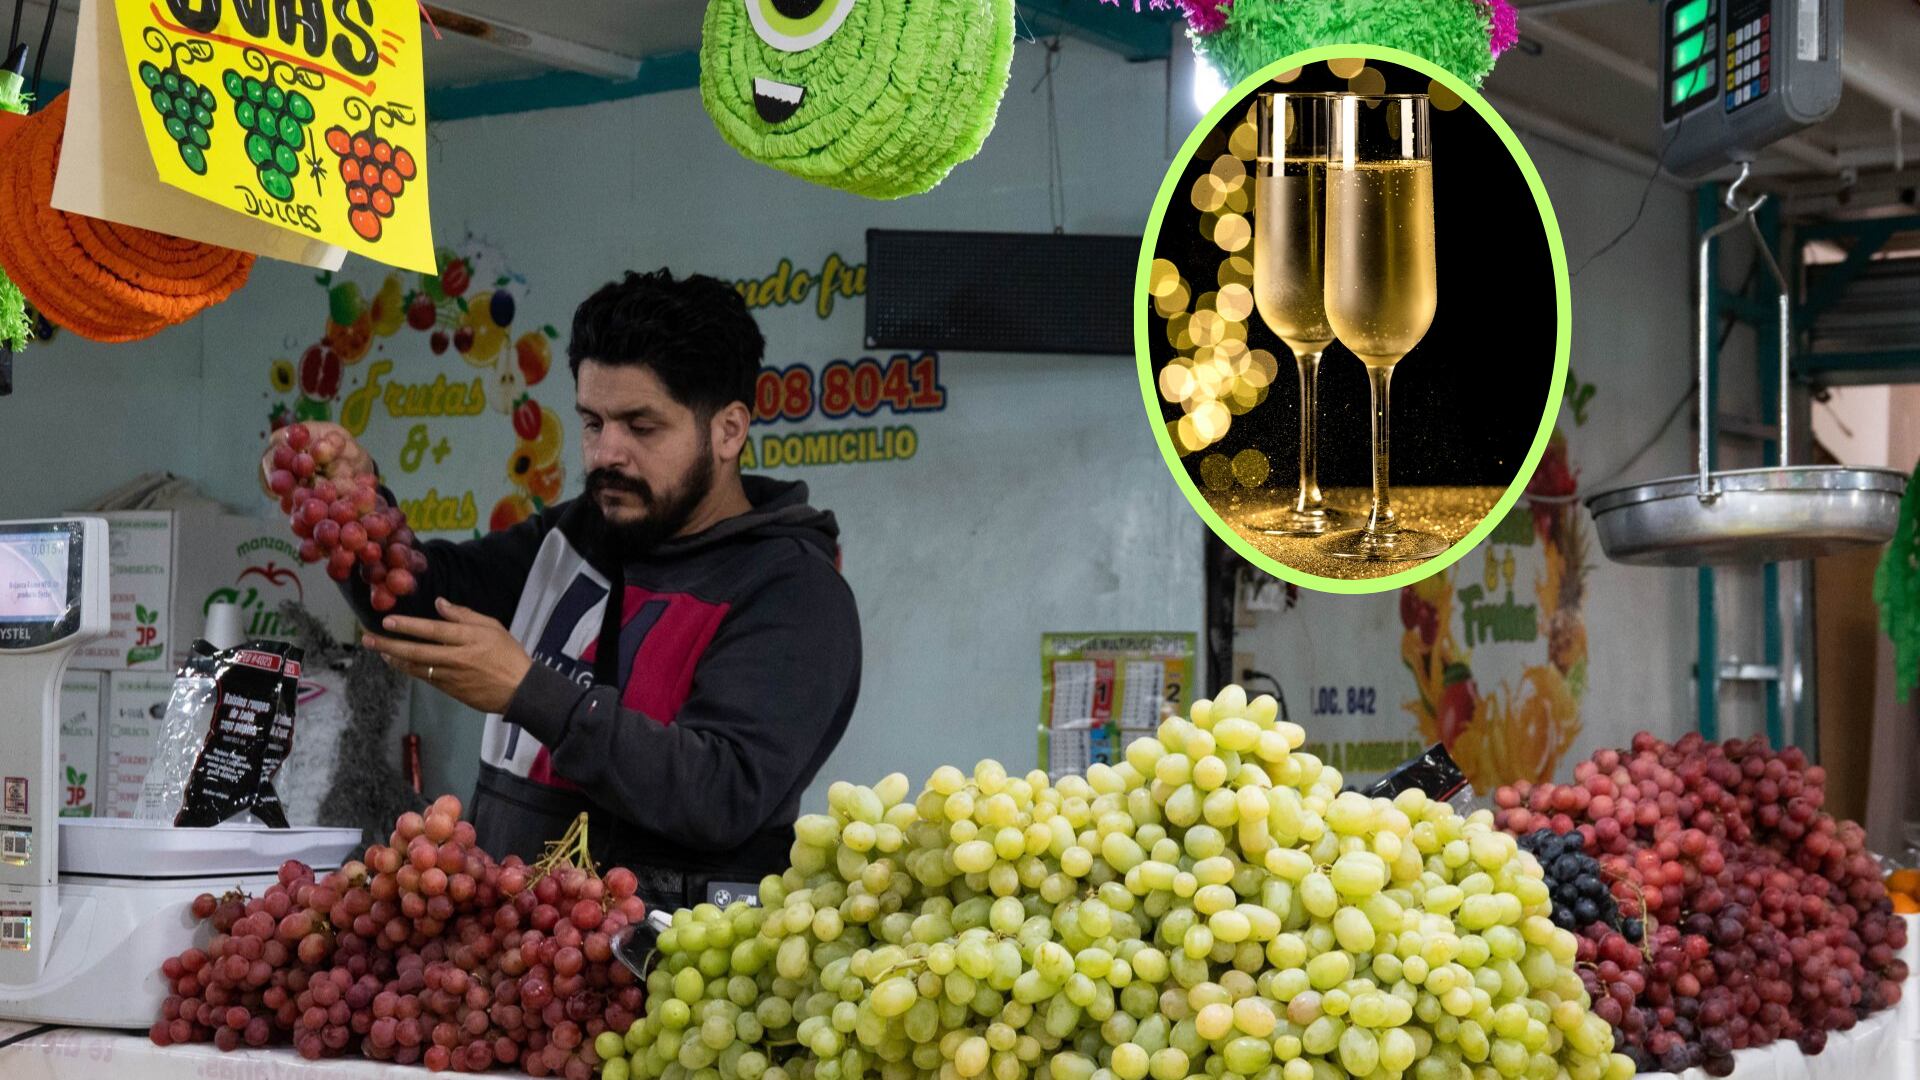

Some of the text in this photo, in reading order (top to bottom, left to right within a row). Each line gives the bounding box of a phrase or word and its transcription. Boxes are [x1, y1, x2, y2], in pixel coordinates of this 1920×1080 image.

[235, 185, 321, 232] DULCES
[341, 359, 486, 438] Frutas
[753, 350, 946, 425] 08 8041
[761, 425, 918, 469] DOMICILIO
[400, 488, 478, 531] utas
[136, 626, 157, 646] JP
[1166, 683, 1180, 703] 2
[1346, 686, 1377, 715] 842
[66, 786, 86, 806] JP
